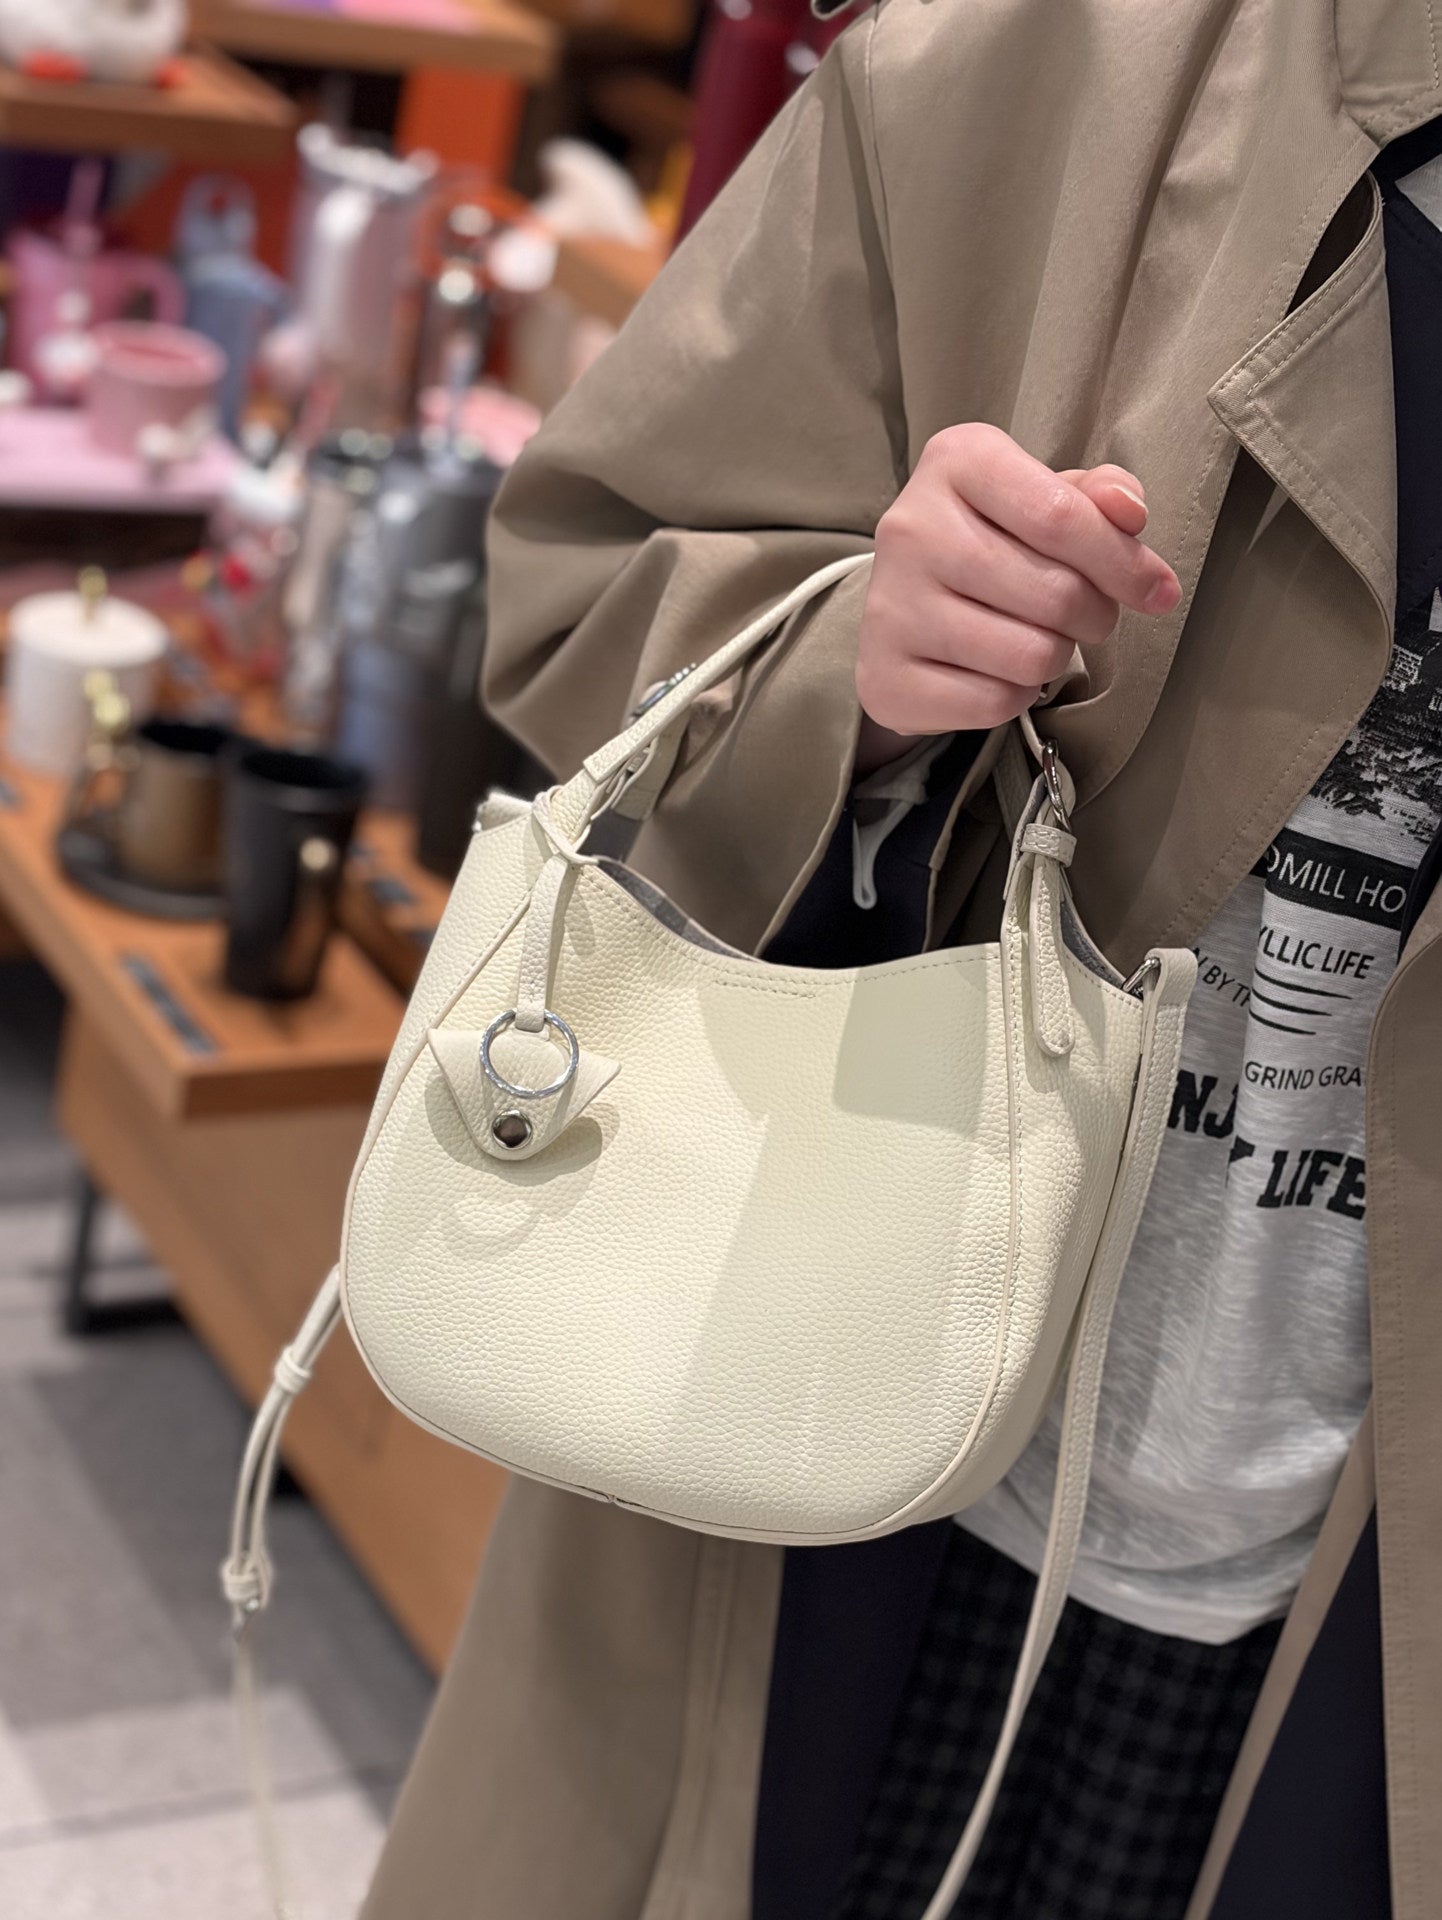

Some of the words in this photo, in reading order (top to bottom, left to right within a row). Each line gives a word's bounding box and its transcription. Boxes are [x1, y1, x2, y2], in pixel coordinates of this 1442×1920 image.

[1355, 876, 1407, 913] HO
[1202, 965, 1235, 991] BY
[1321, 947, 1375, 979] LIFE
[1244, 1061, 1314, 1090] GRIND
[1318, 1065, 1361, 1087] GRA
[1256, 1149, 1366, 1220] LIFE
